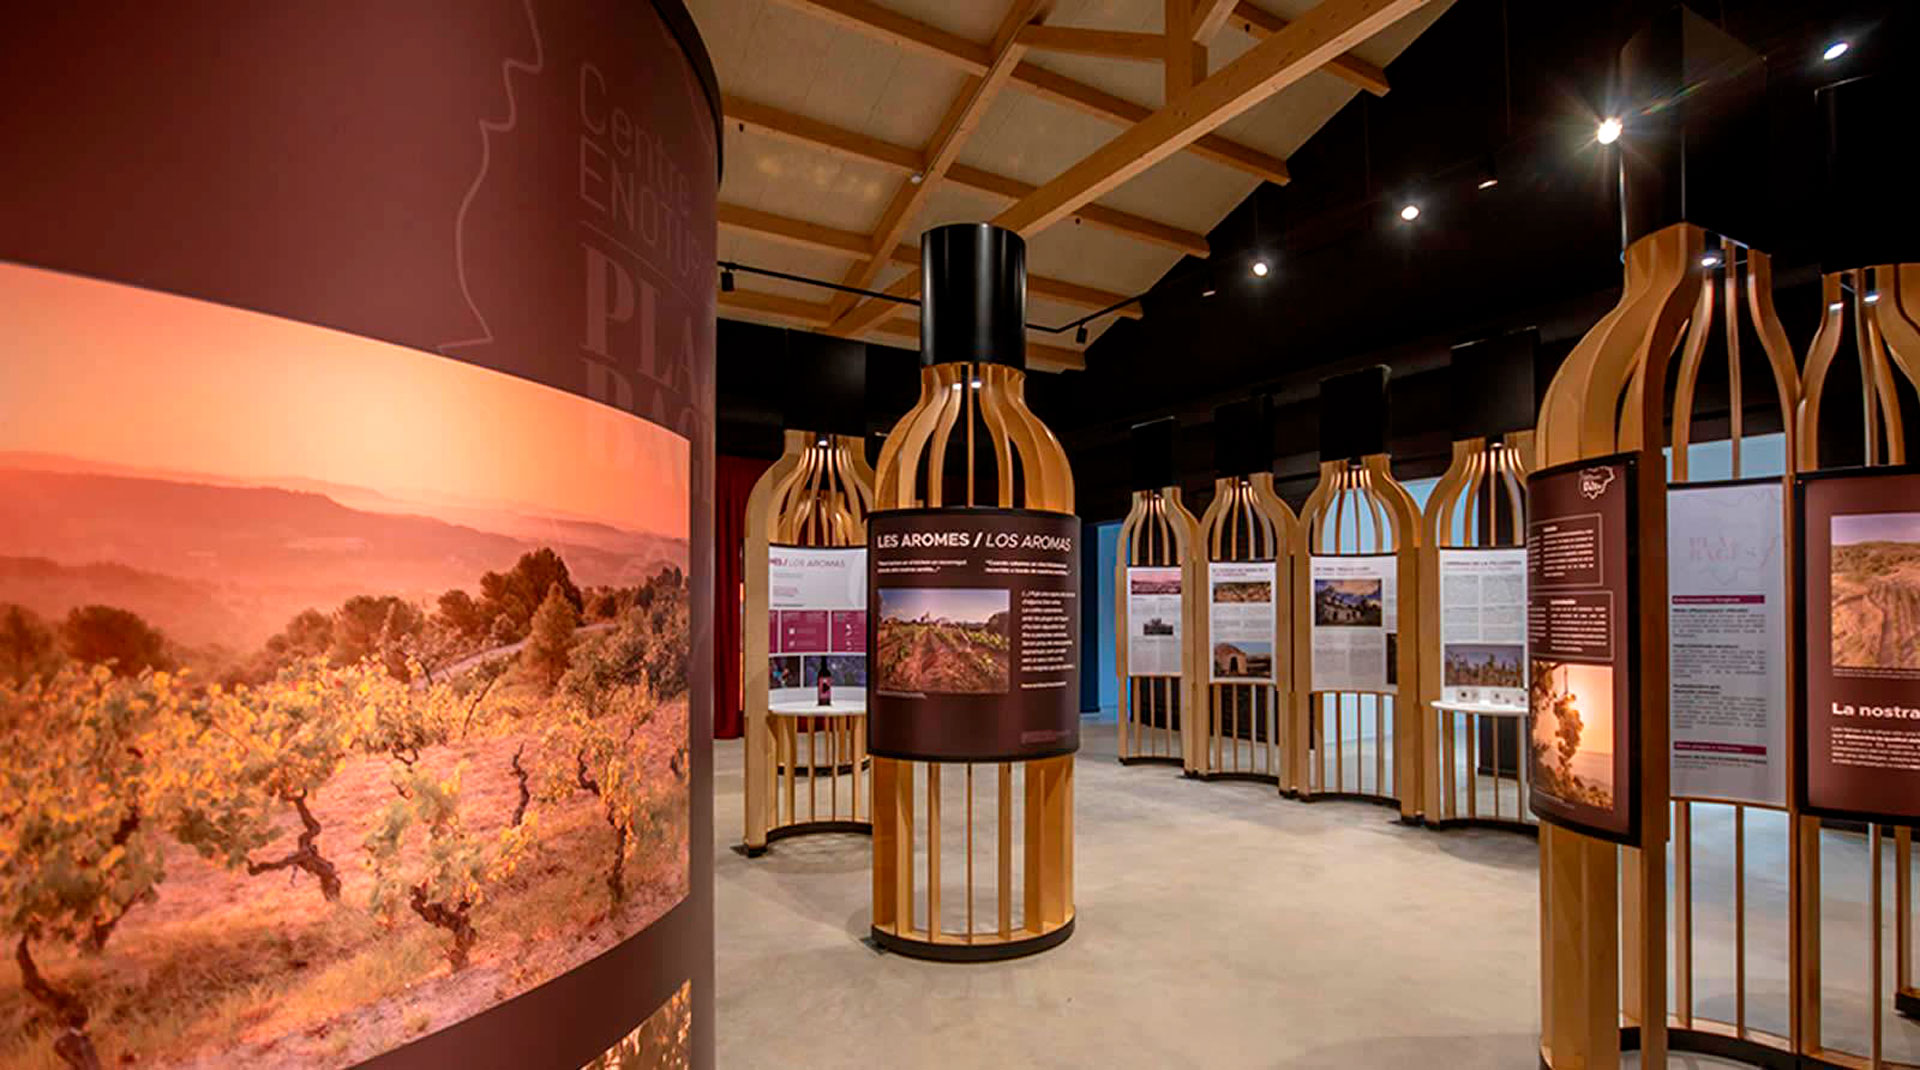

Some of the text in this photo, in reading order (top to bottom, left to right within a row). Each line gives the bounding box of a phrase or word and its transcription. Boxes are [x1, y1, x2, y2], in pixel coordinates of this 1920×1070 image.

[580, 63, 692, 218] Centre
[579, 241, 704, 408] PLA
[876, 534, 898, 548] LES
[901, 532, 970, 548] AROMES
[985, 533, 1019, 548] LOS
[1020, 535, 1072, 552] AROMAS
[1832, 702, 1920, 719] La nostra
